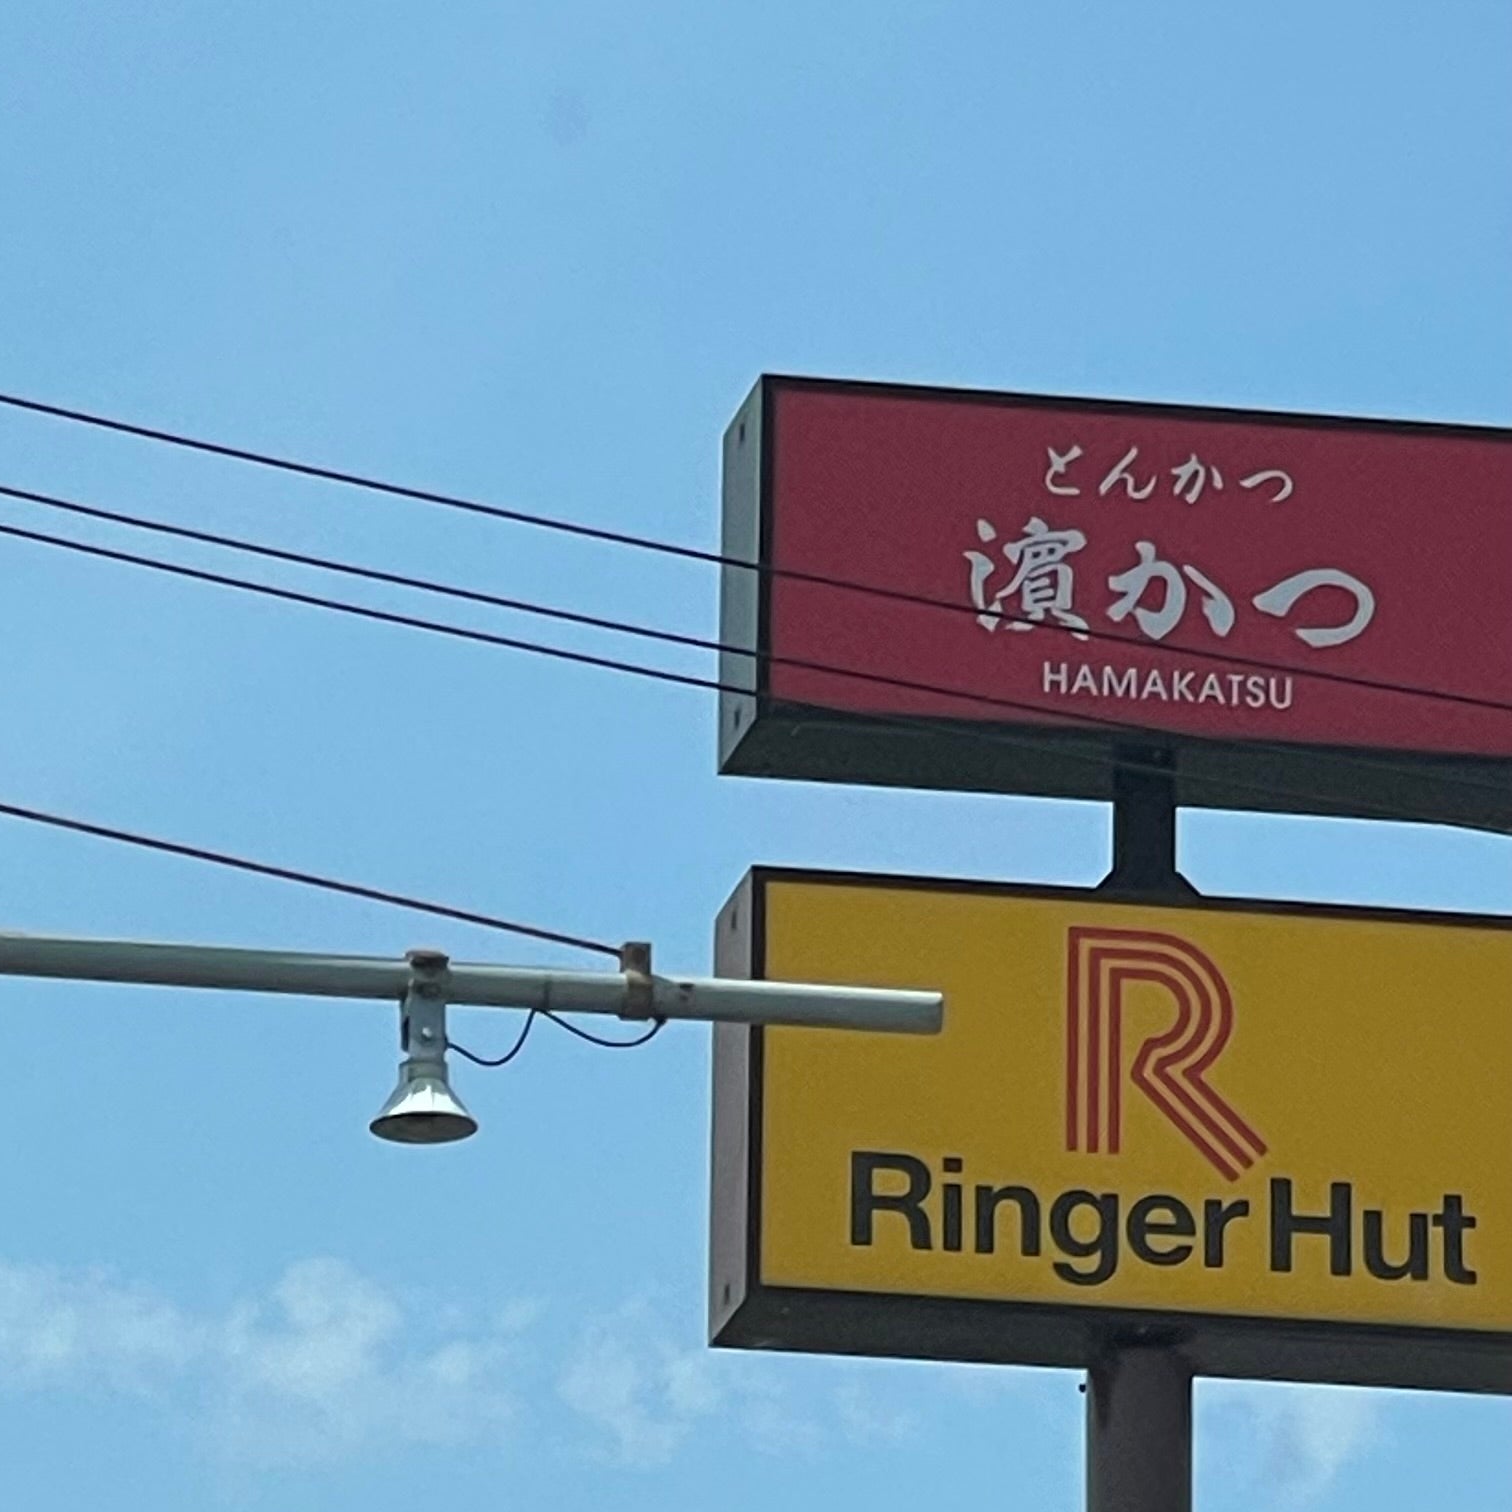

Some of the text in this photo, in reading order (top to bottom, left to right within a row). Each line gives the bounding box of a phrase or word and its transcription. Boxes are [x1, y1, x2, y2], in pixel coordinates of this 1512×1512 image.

[1044, 444, 1294, 504] とんかつ
[962, 515, 1376, 649] 濱かつ
[1042, 661, 1294, 710] HAMAKATSU
[1065, 925, 1269, 1183] R
[848, 1149, 1478, 1287] Ringer Hut
